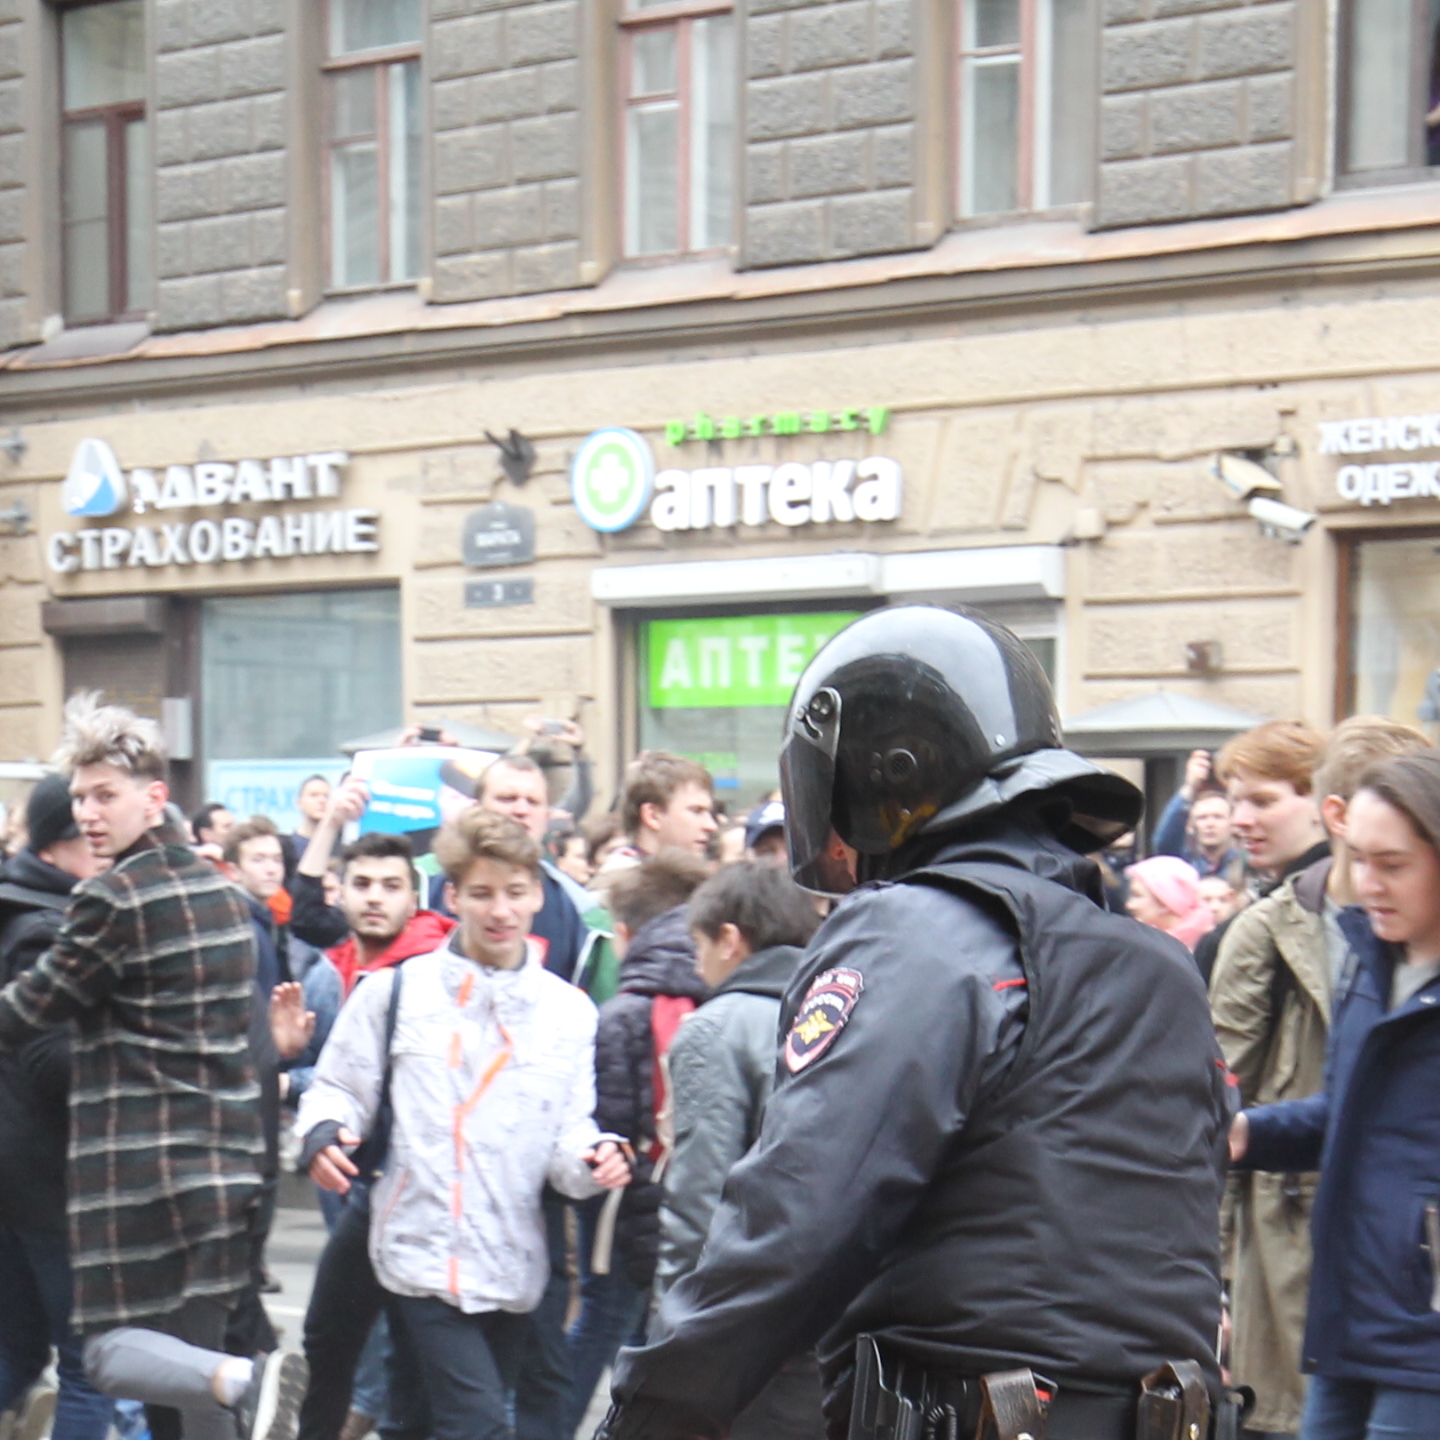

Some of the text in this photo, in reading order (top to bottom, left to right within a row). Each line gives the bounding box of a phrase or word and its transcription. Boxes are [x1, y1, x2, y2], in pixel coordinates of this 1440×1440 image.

[665, 407, 888, 446] pharmacy
[651, 456, 902, 531] аптека
[48, 508, 381, 573] СТРАХОВАНИЕ
[660, 633, 828, 689] АПТЕ
